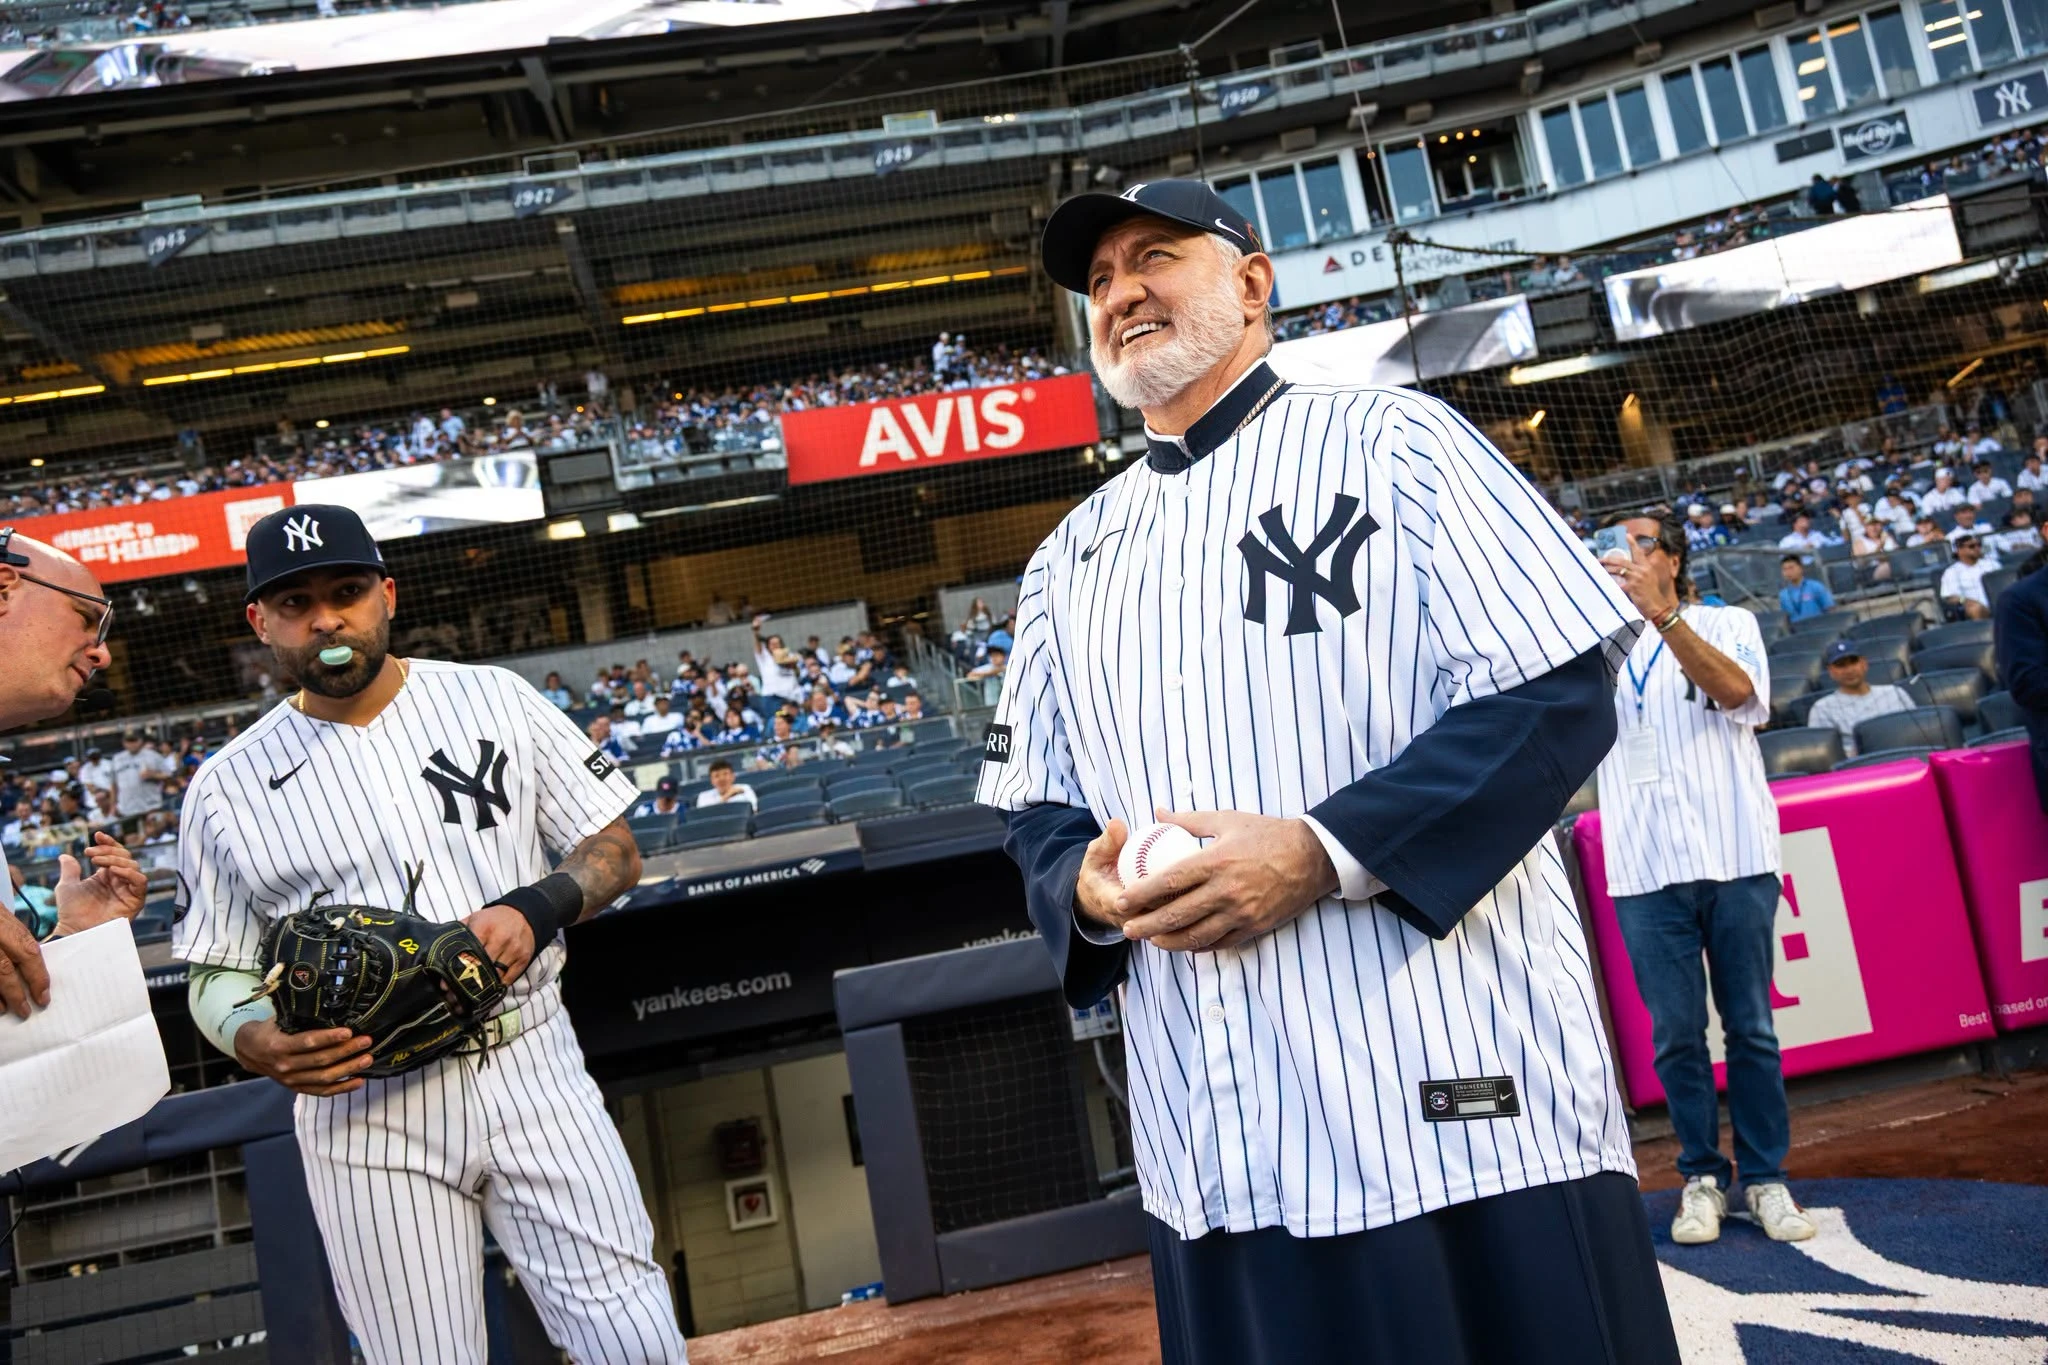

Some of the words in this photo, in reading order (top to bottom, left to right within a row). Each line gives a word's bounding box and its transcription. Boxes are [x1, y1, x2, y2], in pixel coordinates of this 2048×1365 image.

[1993, 80, 2033, 118] NY
[282, 514, 324, 552] NY
[1236, 492, 1382, 637] NY
[590, 755, 612, 775] ST
[420, 739, 512, 831] NY
[687, 881, 724, 897] BANK
[724, 876, 742, 890] OF
[743, 866, 801, 886] AMERICA
[146, 971, 190, 988] MERIC
[632, 971, 792, 1021] yankees.com
[1958, 1011, 1988, 1029] Best
